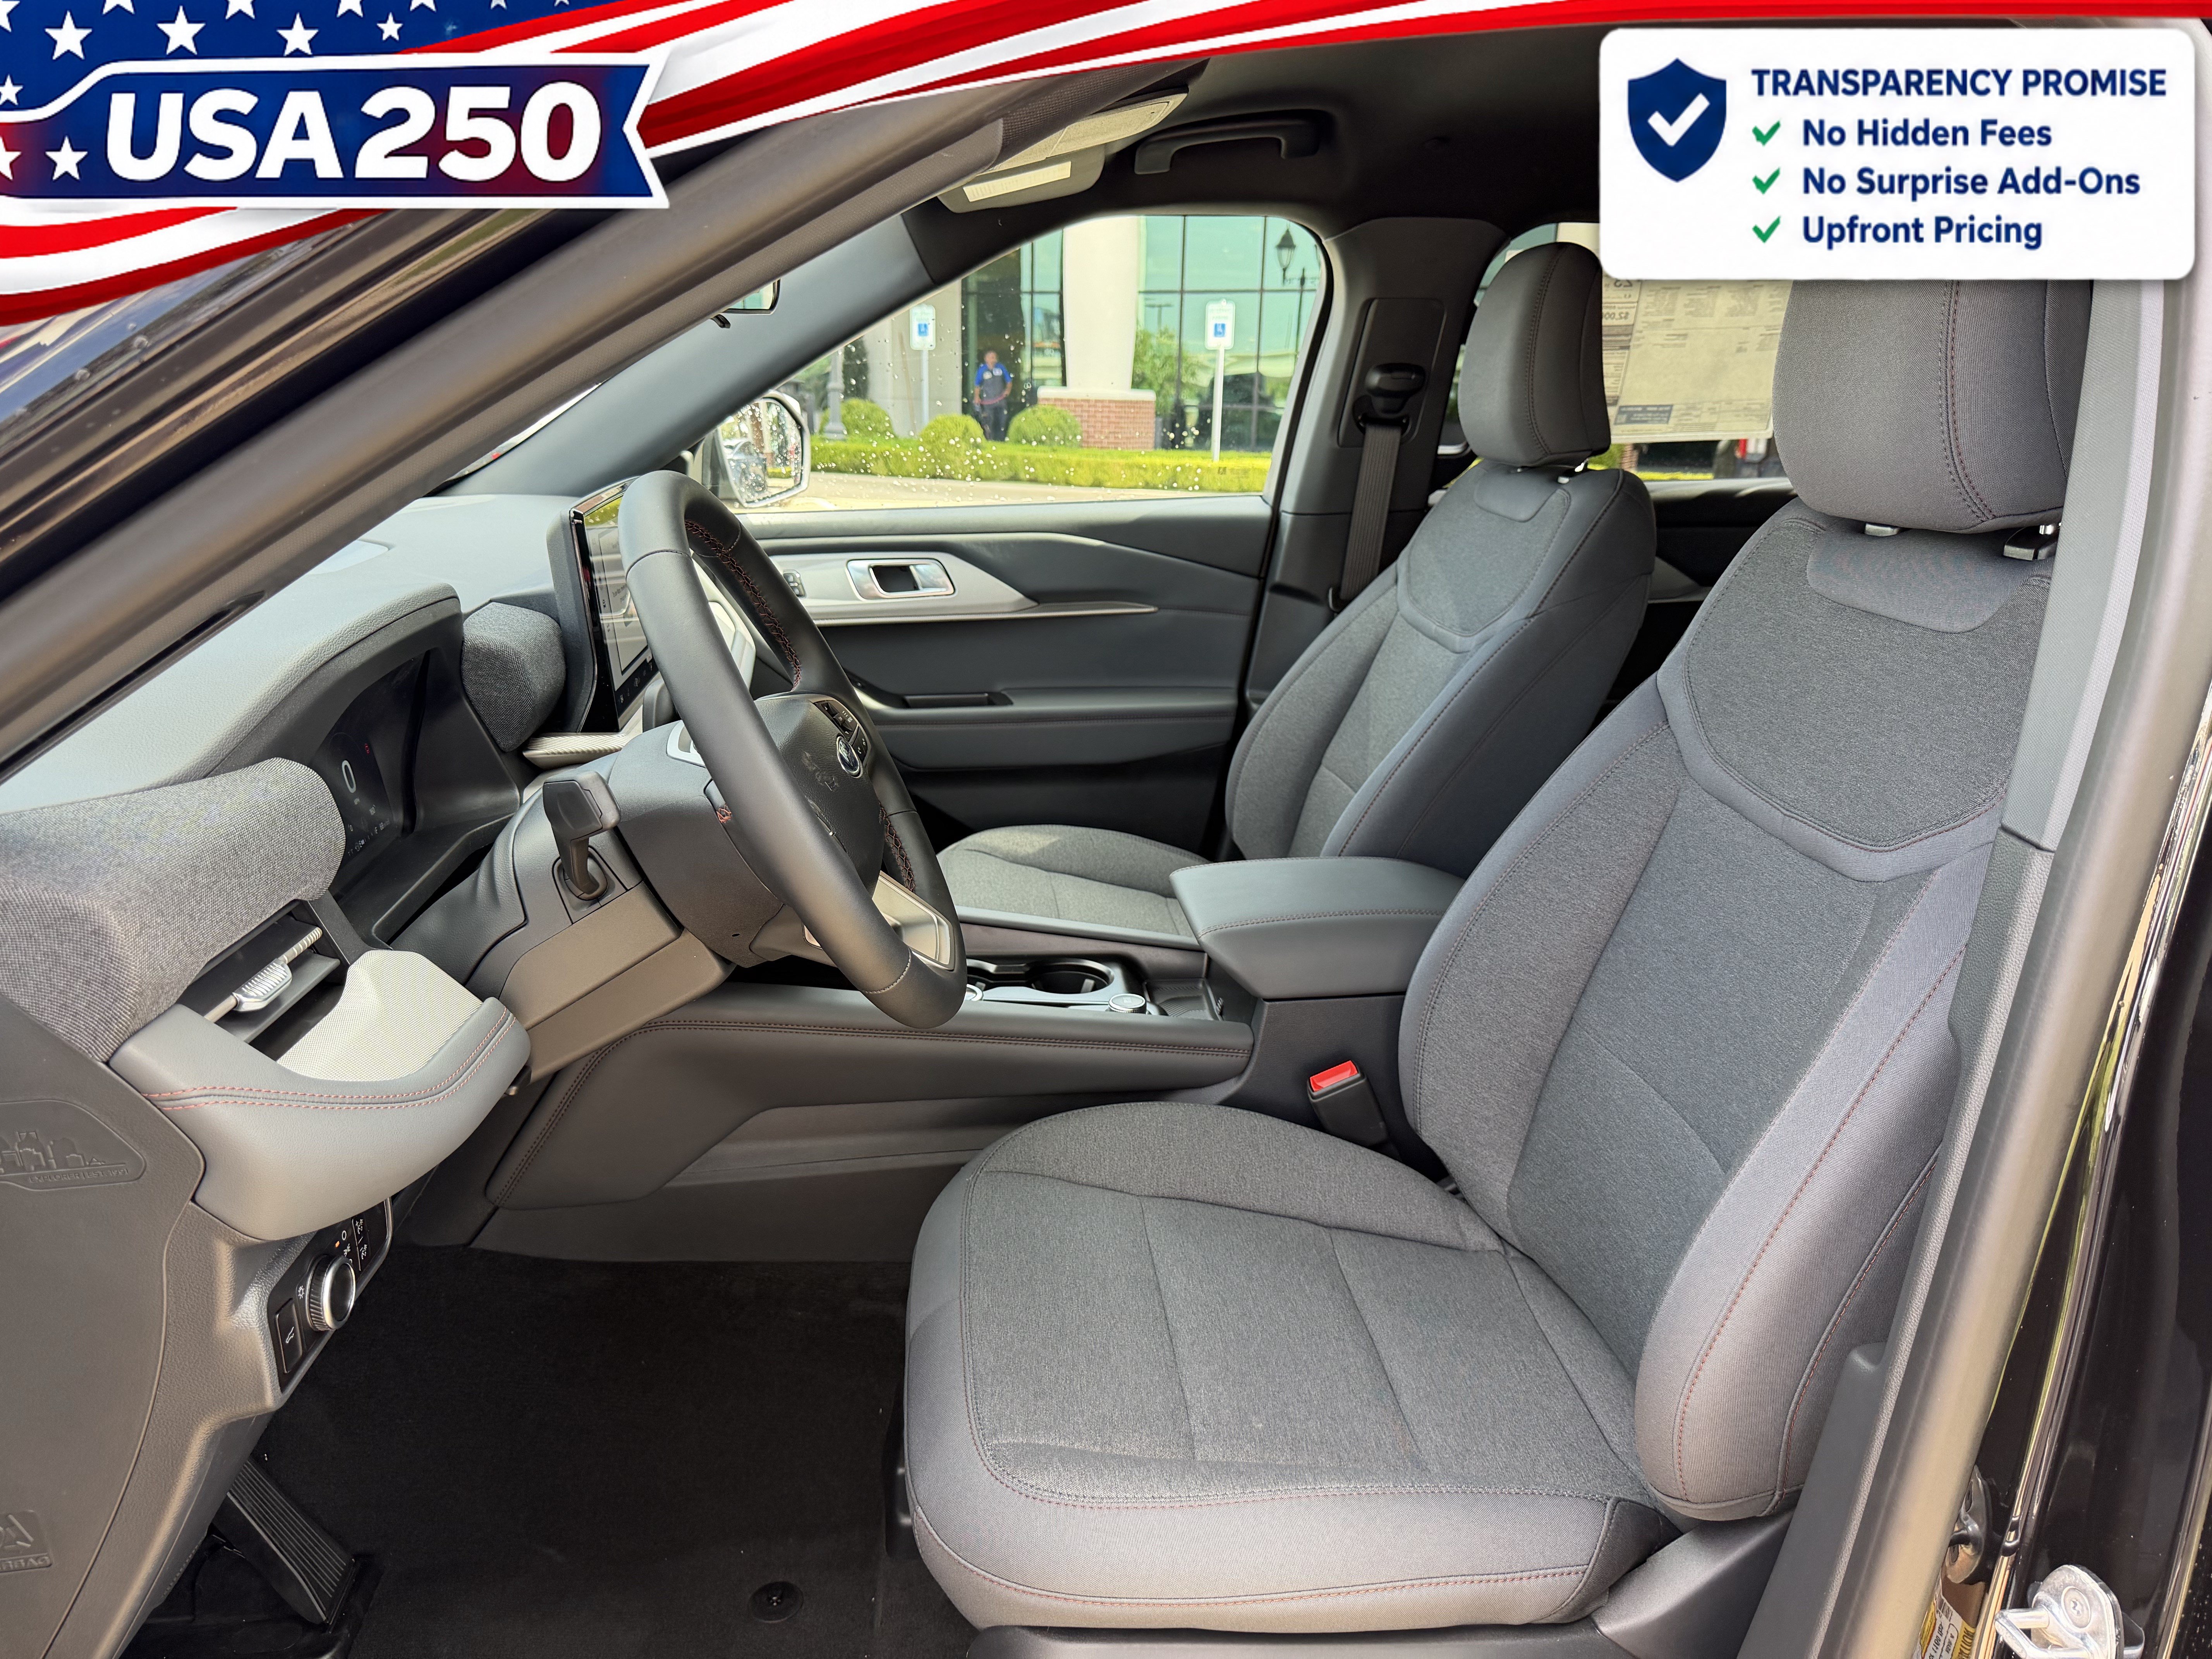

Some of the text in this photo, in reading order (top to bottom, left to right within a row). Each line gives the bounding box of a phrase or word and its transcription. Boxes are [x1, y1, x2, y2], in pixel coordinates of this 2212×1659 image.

[342, 760, 356, 793] 0
[29, 1172, 80, 1183] EXPLORER
[88, 1170, 107, 1178] EST.
